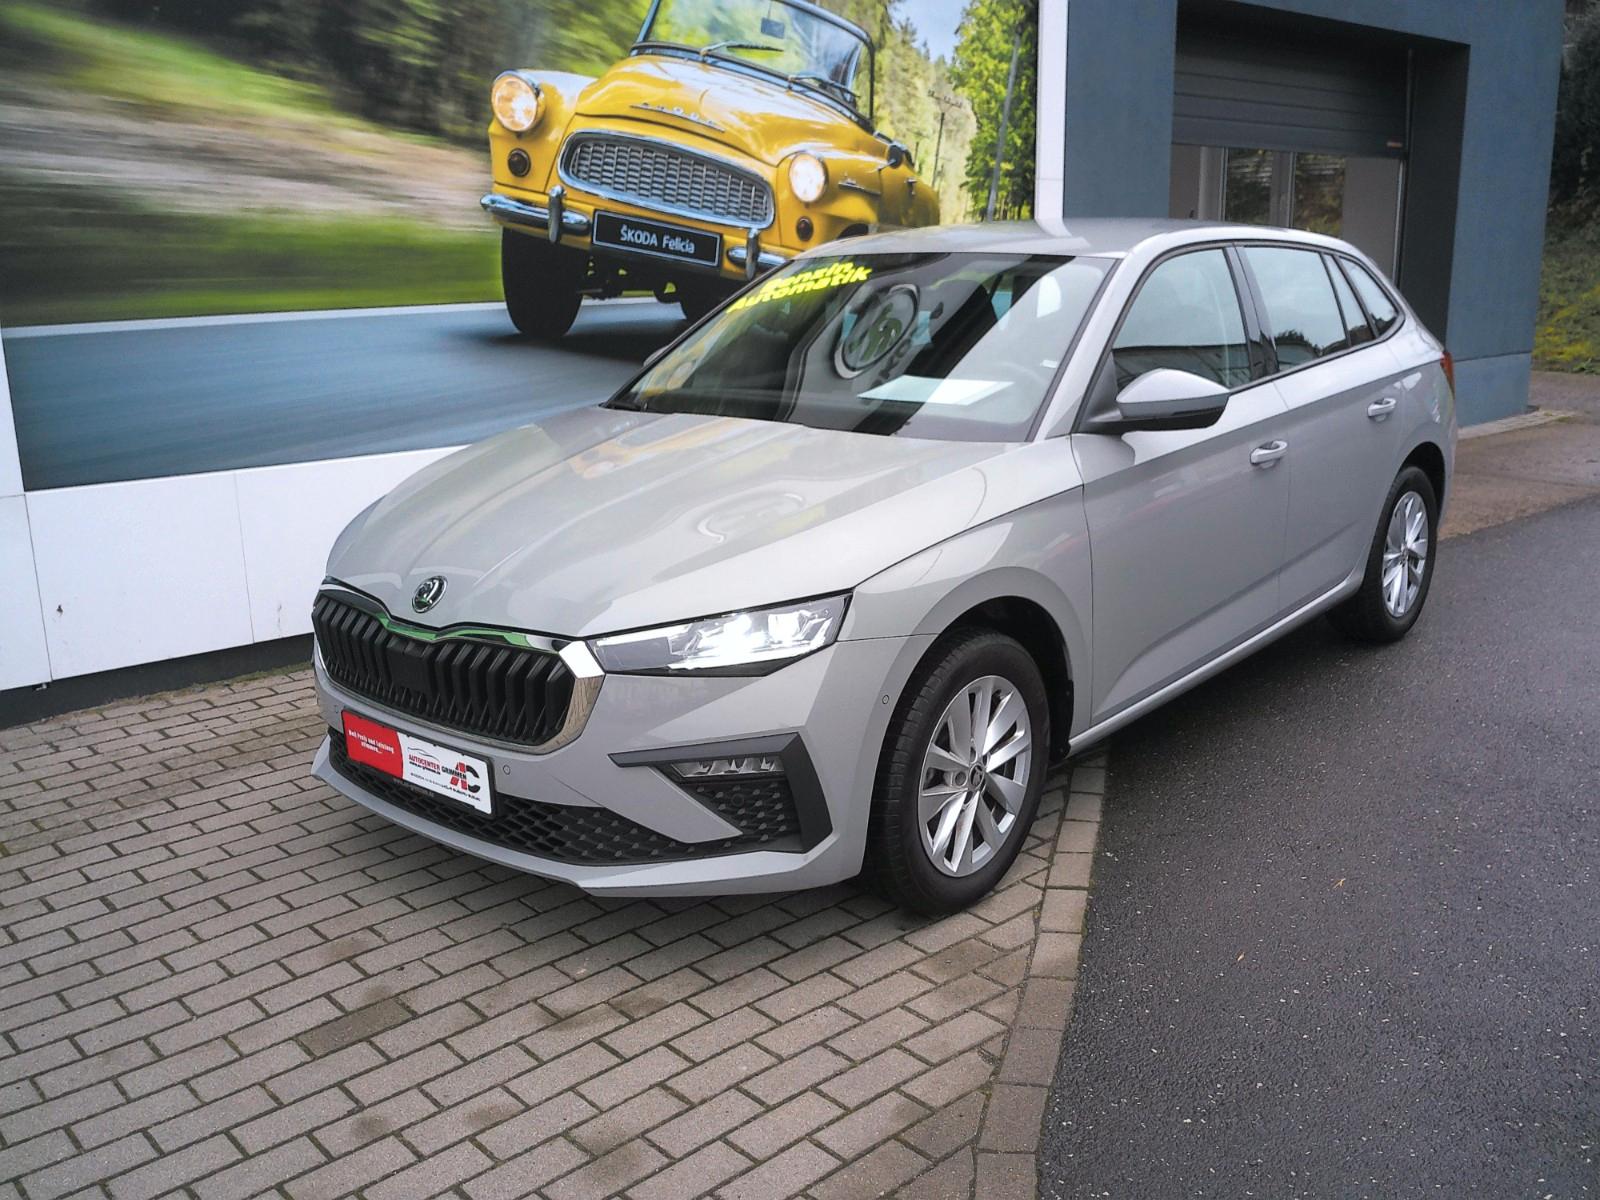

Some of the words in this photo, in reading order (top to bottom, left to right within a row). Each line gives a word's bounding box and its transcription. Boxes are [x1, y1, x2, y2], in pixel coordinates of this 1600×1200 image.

[620, 224, 658, 247] ŠKODA
[662, 235, 695, 254] Felicia
[408, 753, 441, 771] AUTOCENTER
[441, 766, 467, 780] GRIMMEN
